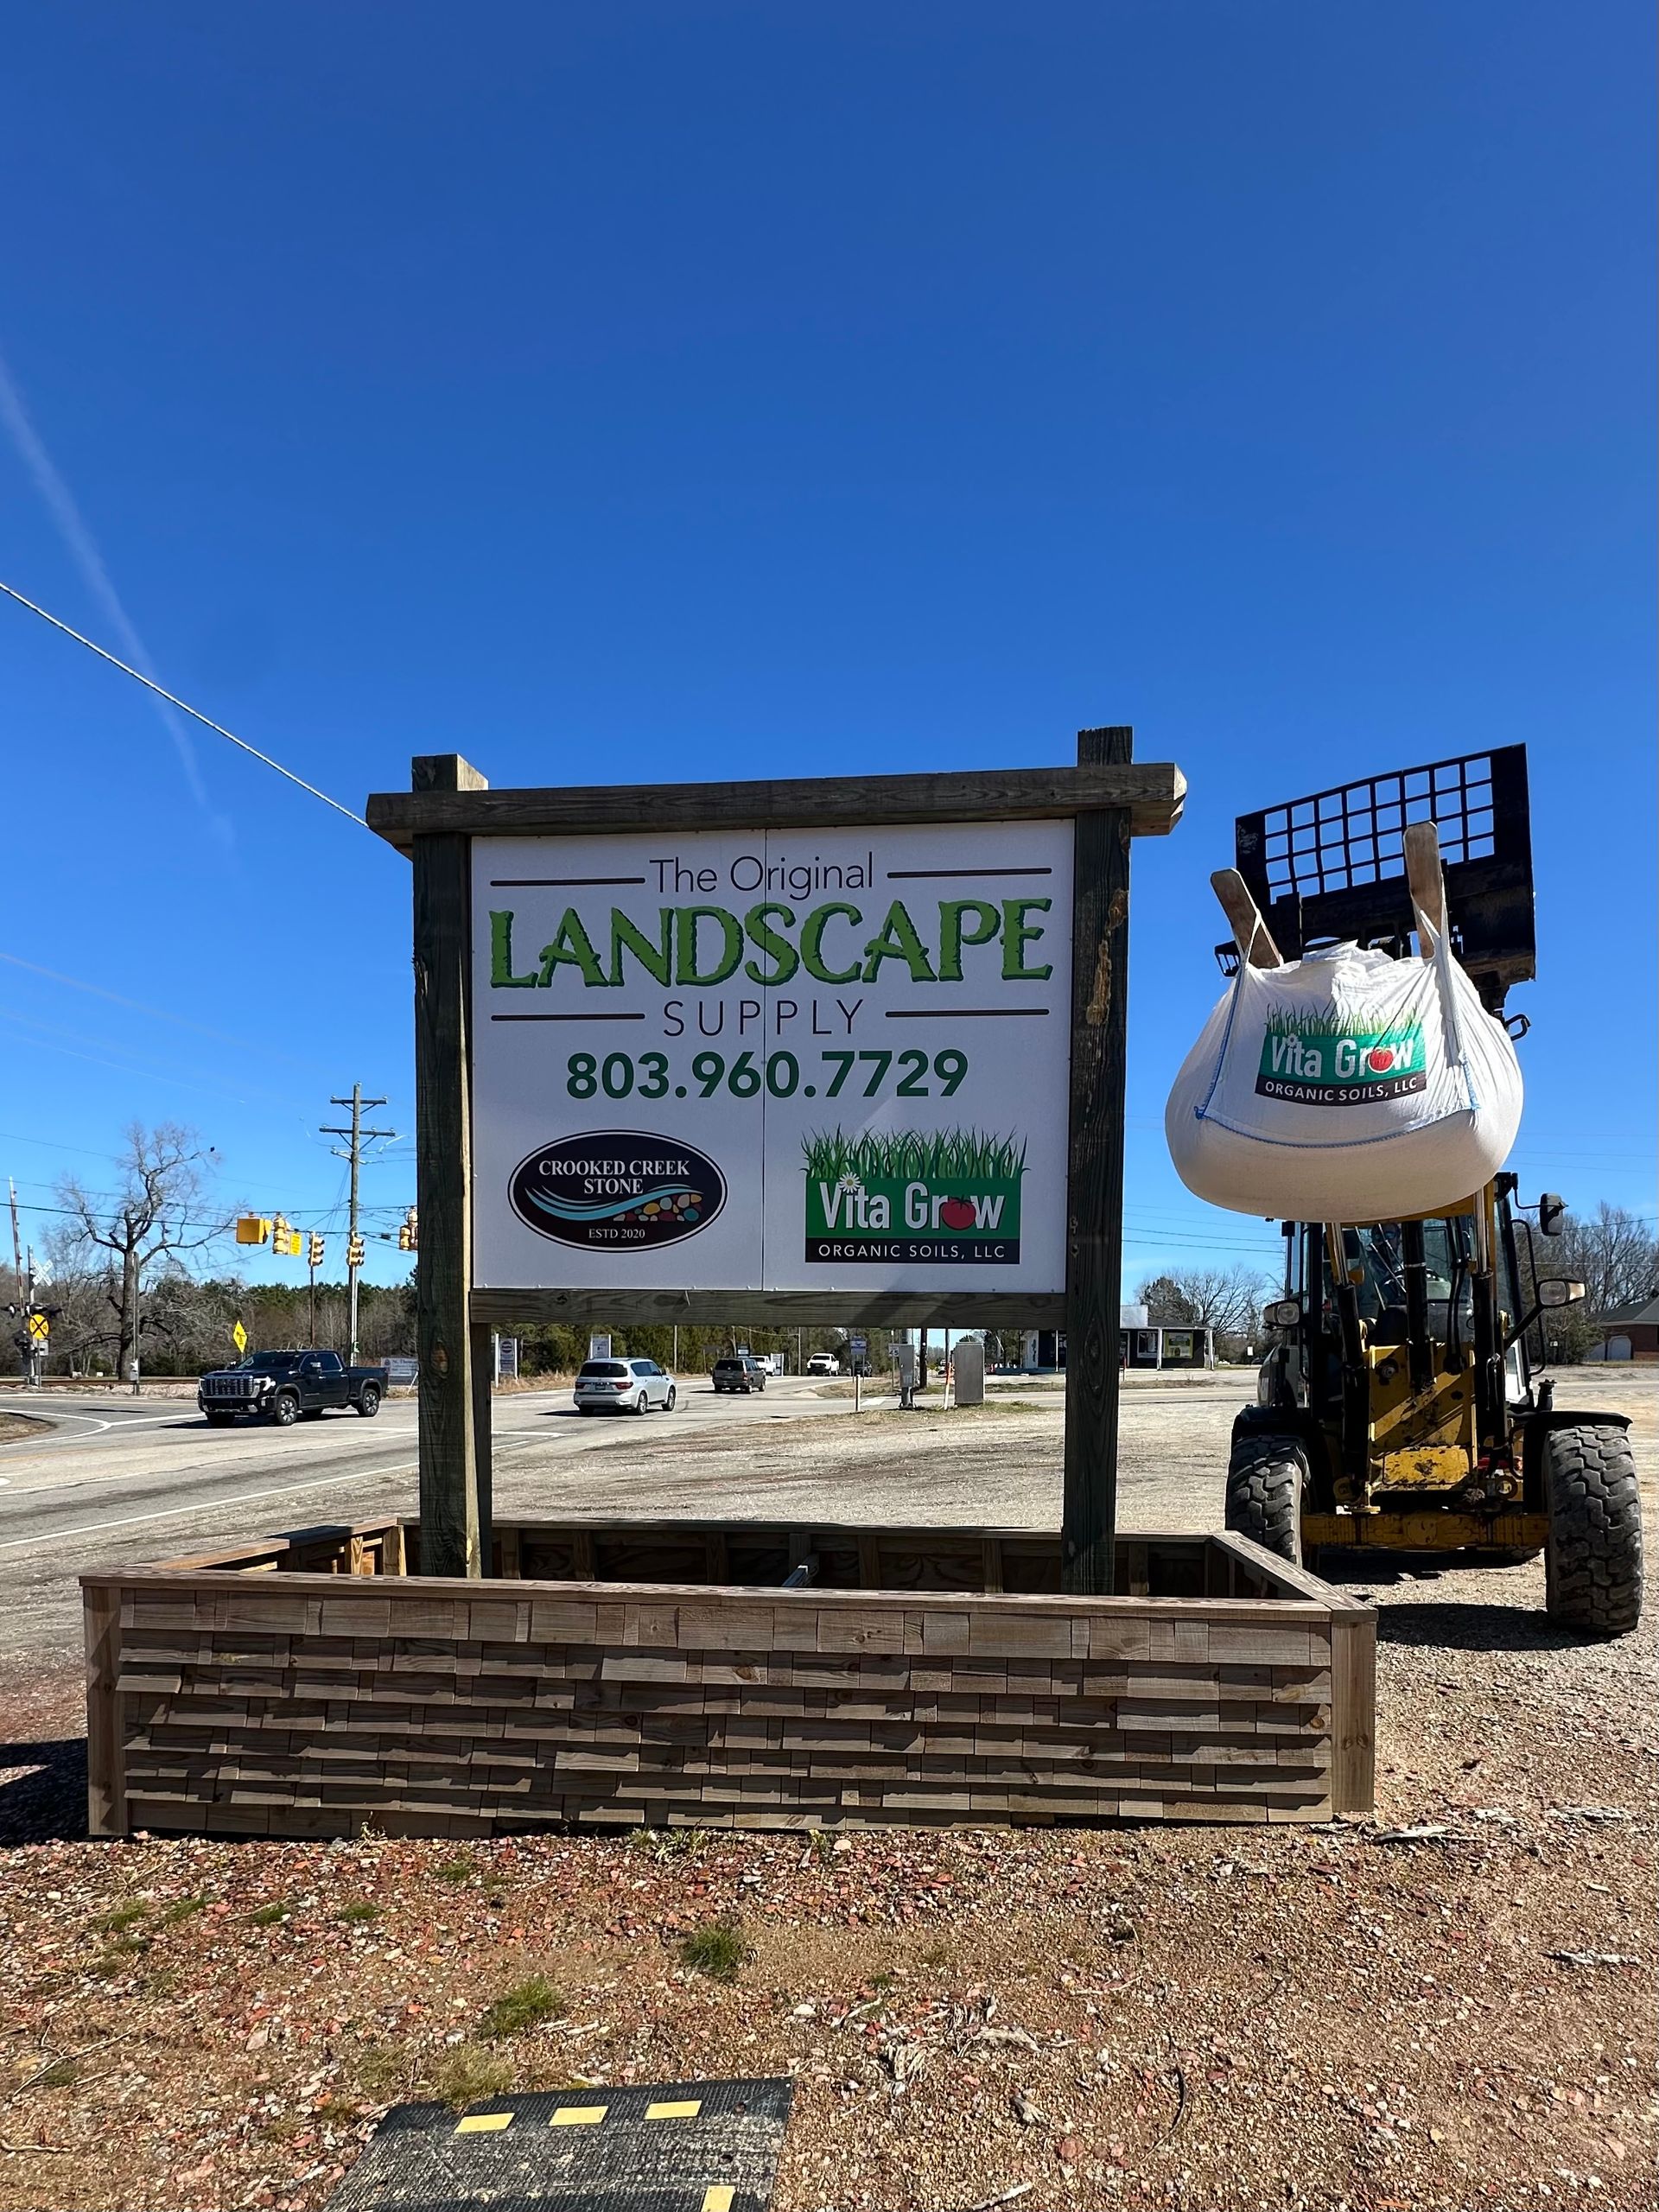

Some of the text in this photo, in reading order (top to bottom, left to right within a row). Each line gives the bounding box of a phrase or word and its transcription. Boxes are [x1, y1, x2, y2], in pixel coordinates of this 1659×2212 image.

[648, 851, 874, 901] The Original
[488, 898, 1054, 988] LANDSCAPE
[663, 998, 864, 1037] SUPPLY
[566, 1048, 969, 1100] 803.960.7729
[1272, 1034, 1323, 1078] Vita
[1265, 1077, 1418, 1102] ORGANIC SOILS, LLC
[537, 1160, 690, 1176] CROOKED CREEK
[583, 1178, 645, 1194] STONE
[818, 1180, 891, 1230] Vita
[588, 1229, 646, 1239] ESTD 2020
[818, 1244, 1006, 1260] ORGANIC SOILS, LLC
